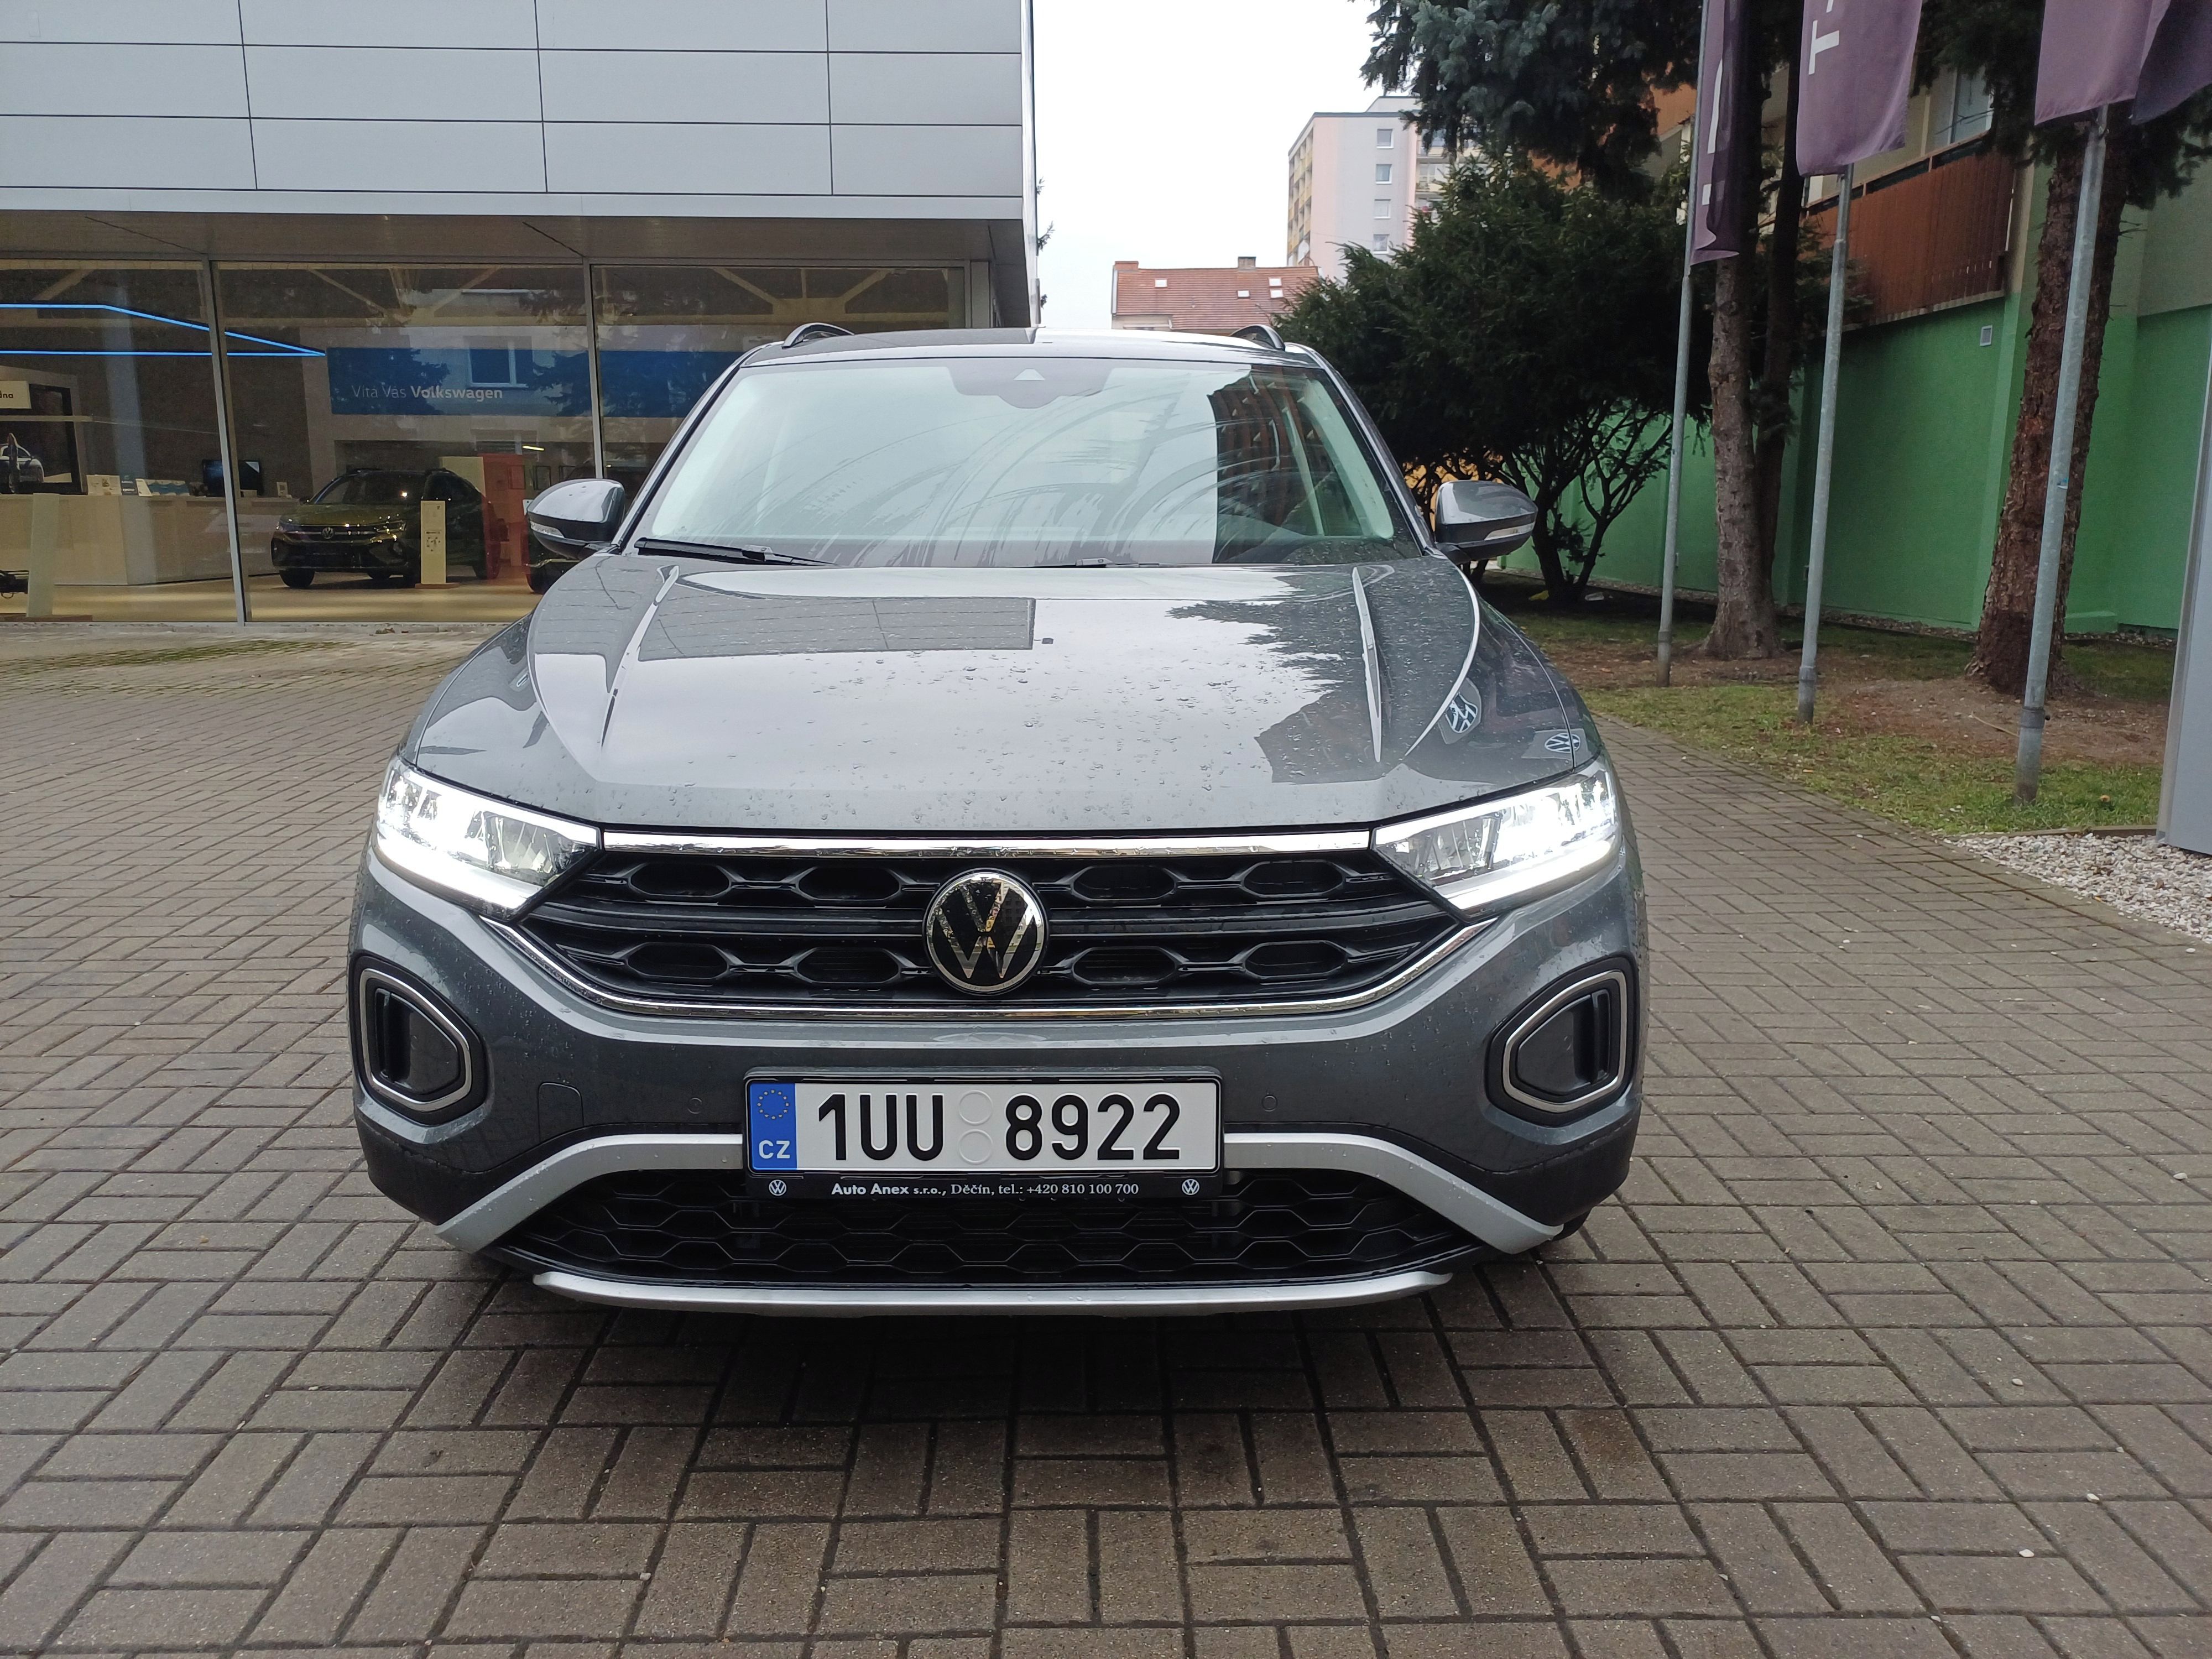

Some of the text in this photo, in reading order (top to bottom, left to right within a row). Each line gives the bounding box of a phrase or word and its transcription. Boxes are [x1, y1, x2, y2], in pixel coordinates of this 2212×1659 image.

[410, 385, 503, 402] Volkswagen
[818, 1093, 1181, 1161] 1UU 8922
[758, 1140, 791, 1160] CZ
[831, 1183, 1139, 1196] Auto Anex s.r.o., Děčín, tel.: +420 810 100 700
